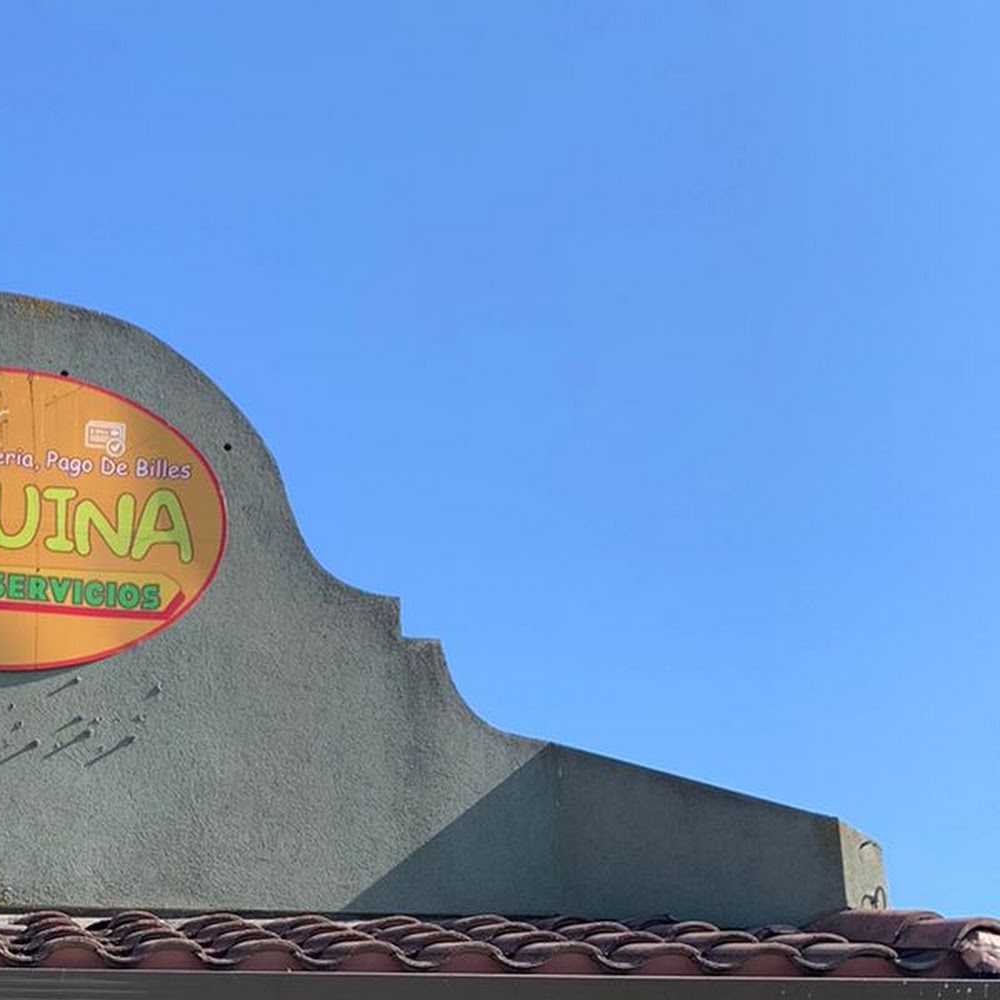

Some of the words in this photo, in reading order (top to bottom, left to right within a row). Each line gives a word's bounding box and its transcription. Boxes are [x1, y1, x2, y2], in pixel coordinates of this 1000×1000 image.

[45, 449, 94, 477] Pago
[100, 456, 129, 476] De
[135, 457, 192, 480] Billes
